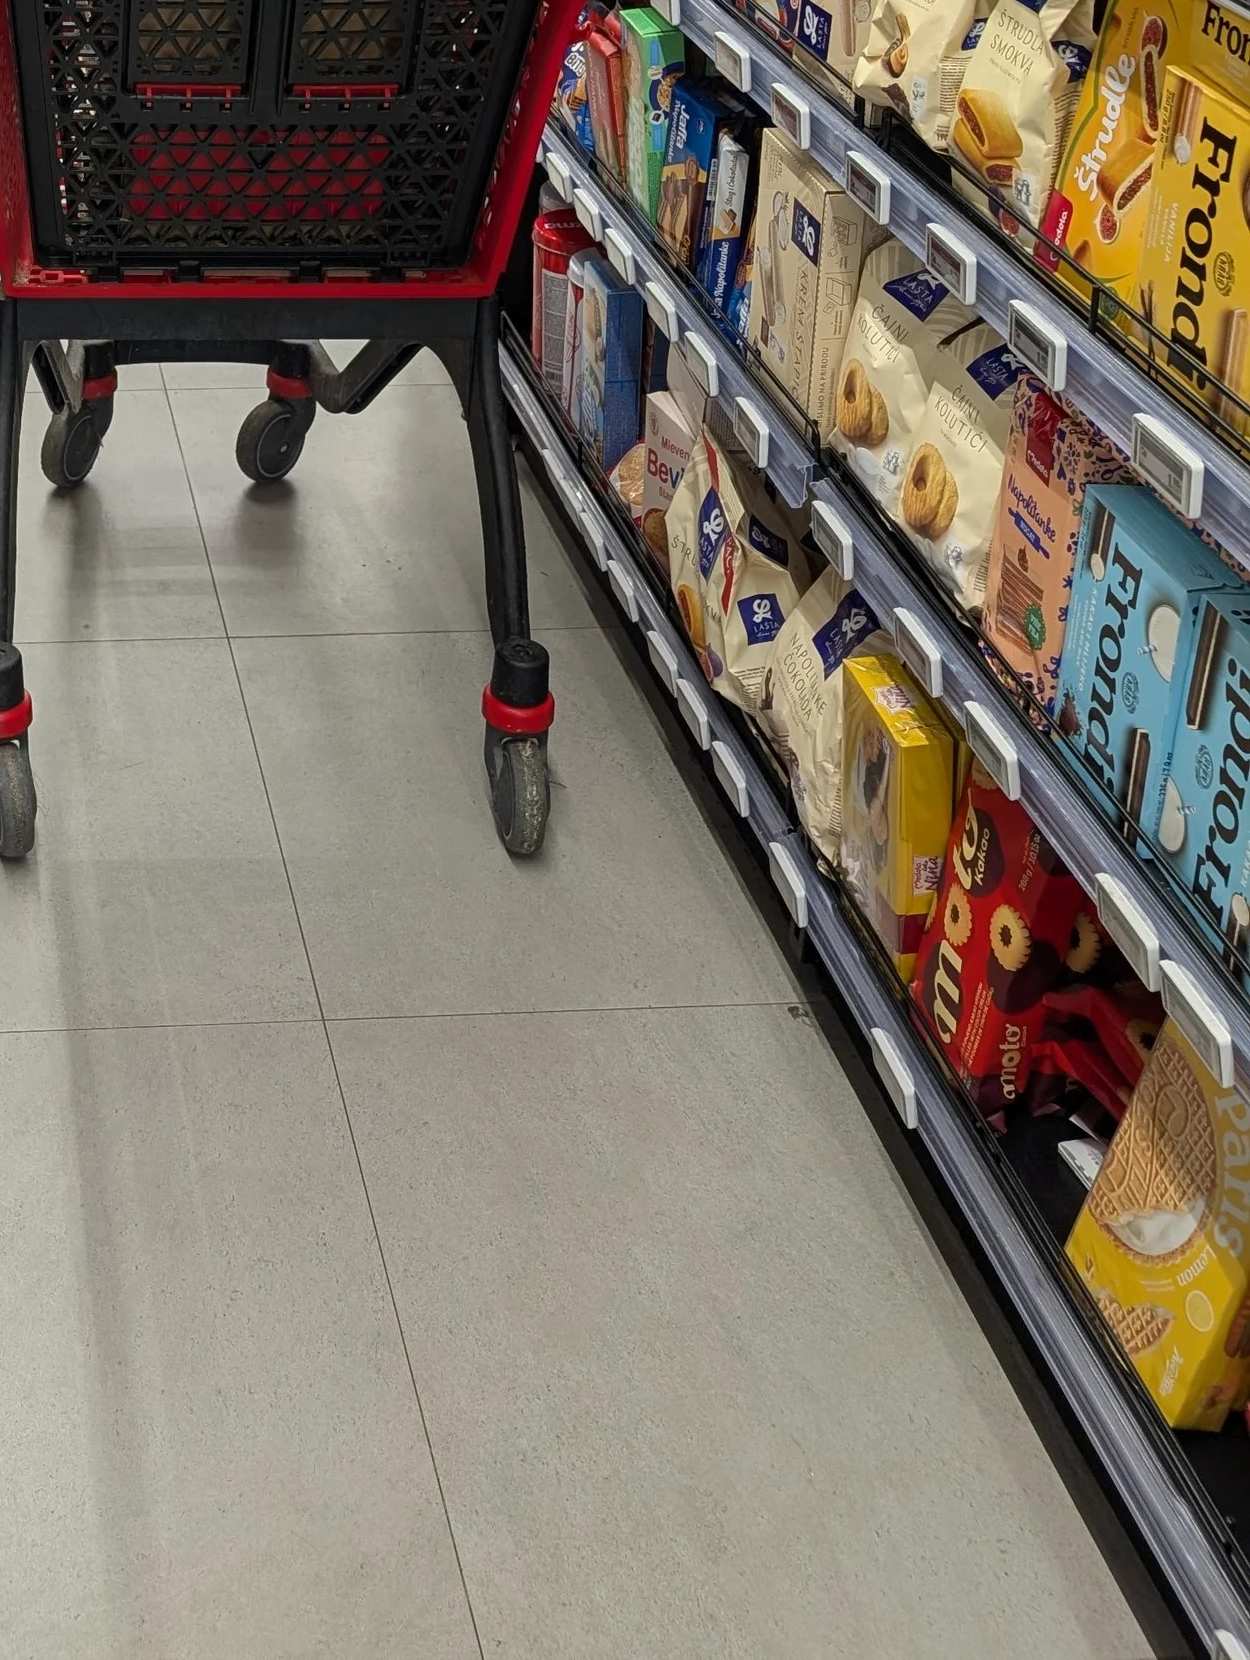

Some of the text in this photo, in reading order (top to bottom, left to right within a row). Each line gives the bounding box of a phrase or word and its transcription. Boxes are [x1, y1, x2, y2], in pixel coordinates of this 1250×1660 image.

[990, 36, 1035, 75] SMOKVA
[998, 9, 1045, 54] ŠTRUDLA
[1072, 53, 1136, 202] Štrudle
[714, 241, 730, 303] Napolitanke
[1166, 115, 1238, 391] Frondi
[903, 278, 934, 306] LASTA
[857, 313, 901, 364] KOLUTIĆI
[871, 304, 910, 342] ČAJNI
[986, 358, 1010, 382] LASTA
[933, 395, 987, 453] KOLUTIĆI
[951, 385, 980, 423] ČAJNI
[661, 435, 690, 461] Mleven
[1007, 473, 1056, 543] Napolitanke
[753, 621, 781, 634] LASTA
[782, 651, 813, 721] ČOKOLADA
[790, 632, 828, 717] NAPOLITANKE
[1083, 542, 1144, 794] Frondi
[925, 856, 939, 891] Nina
[973, 827, 991, 887] Kakao
[999, 1023, 1022, 1101] moto
[1176, 1242, 1218, 1288] Lemon
